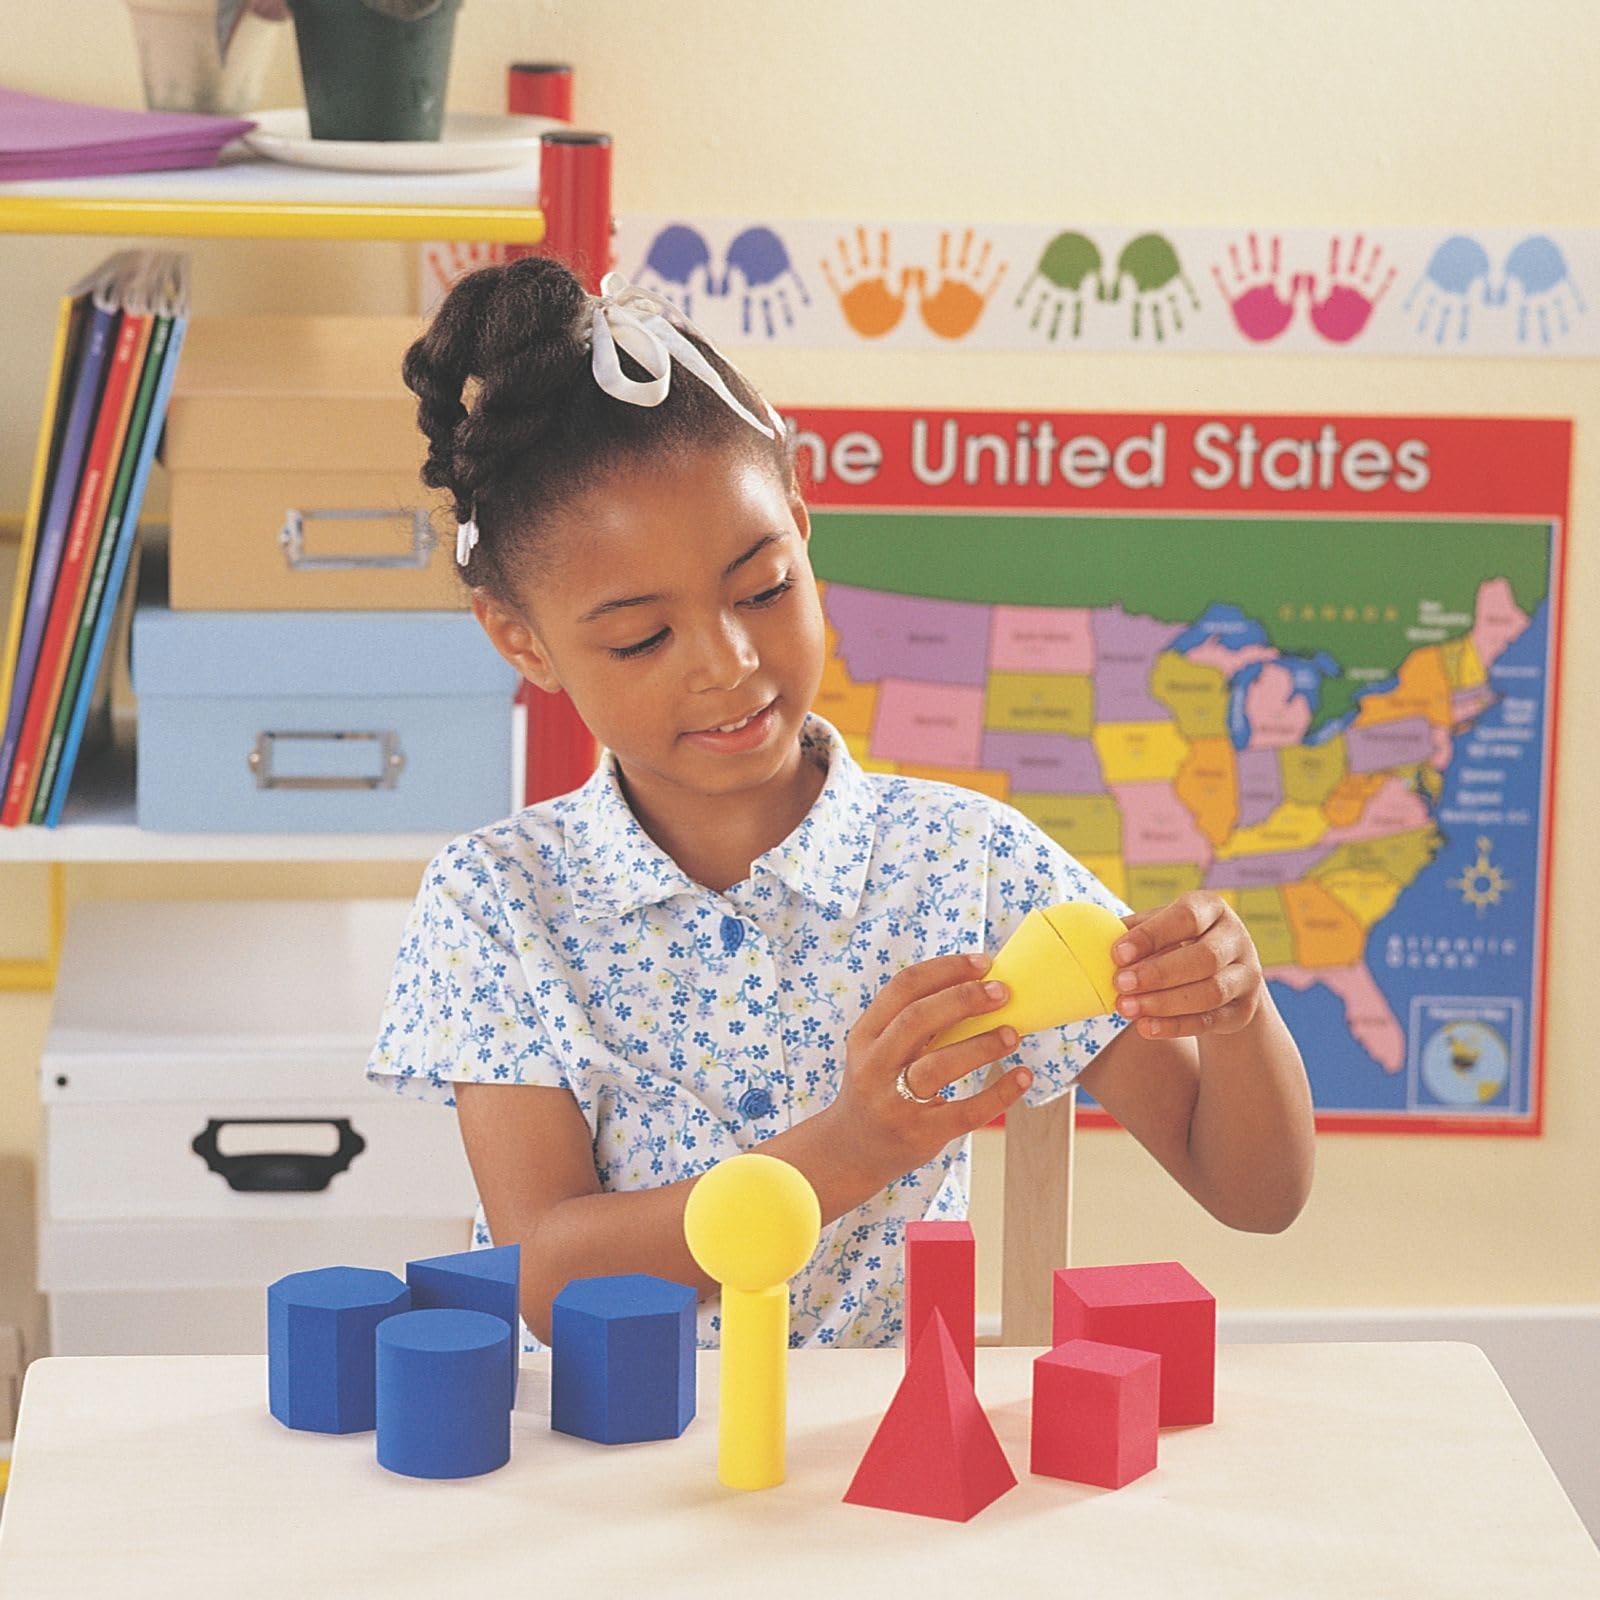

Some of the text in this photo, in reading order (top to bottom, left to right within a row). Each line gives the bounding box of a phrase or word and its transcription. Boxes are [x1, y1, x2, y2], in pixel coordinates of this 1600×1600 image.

[784, 416, 1431, 492] he United States
